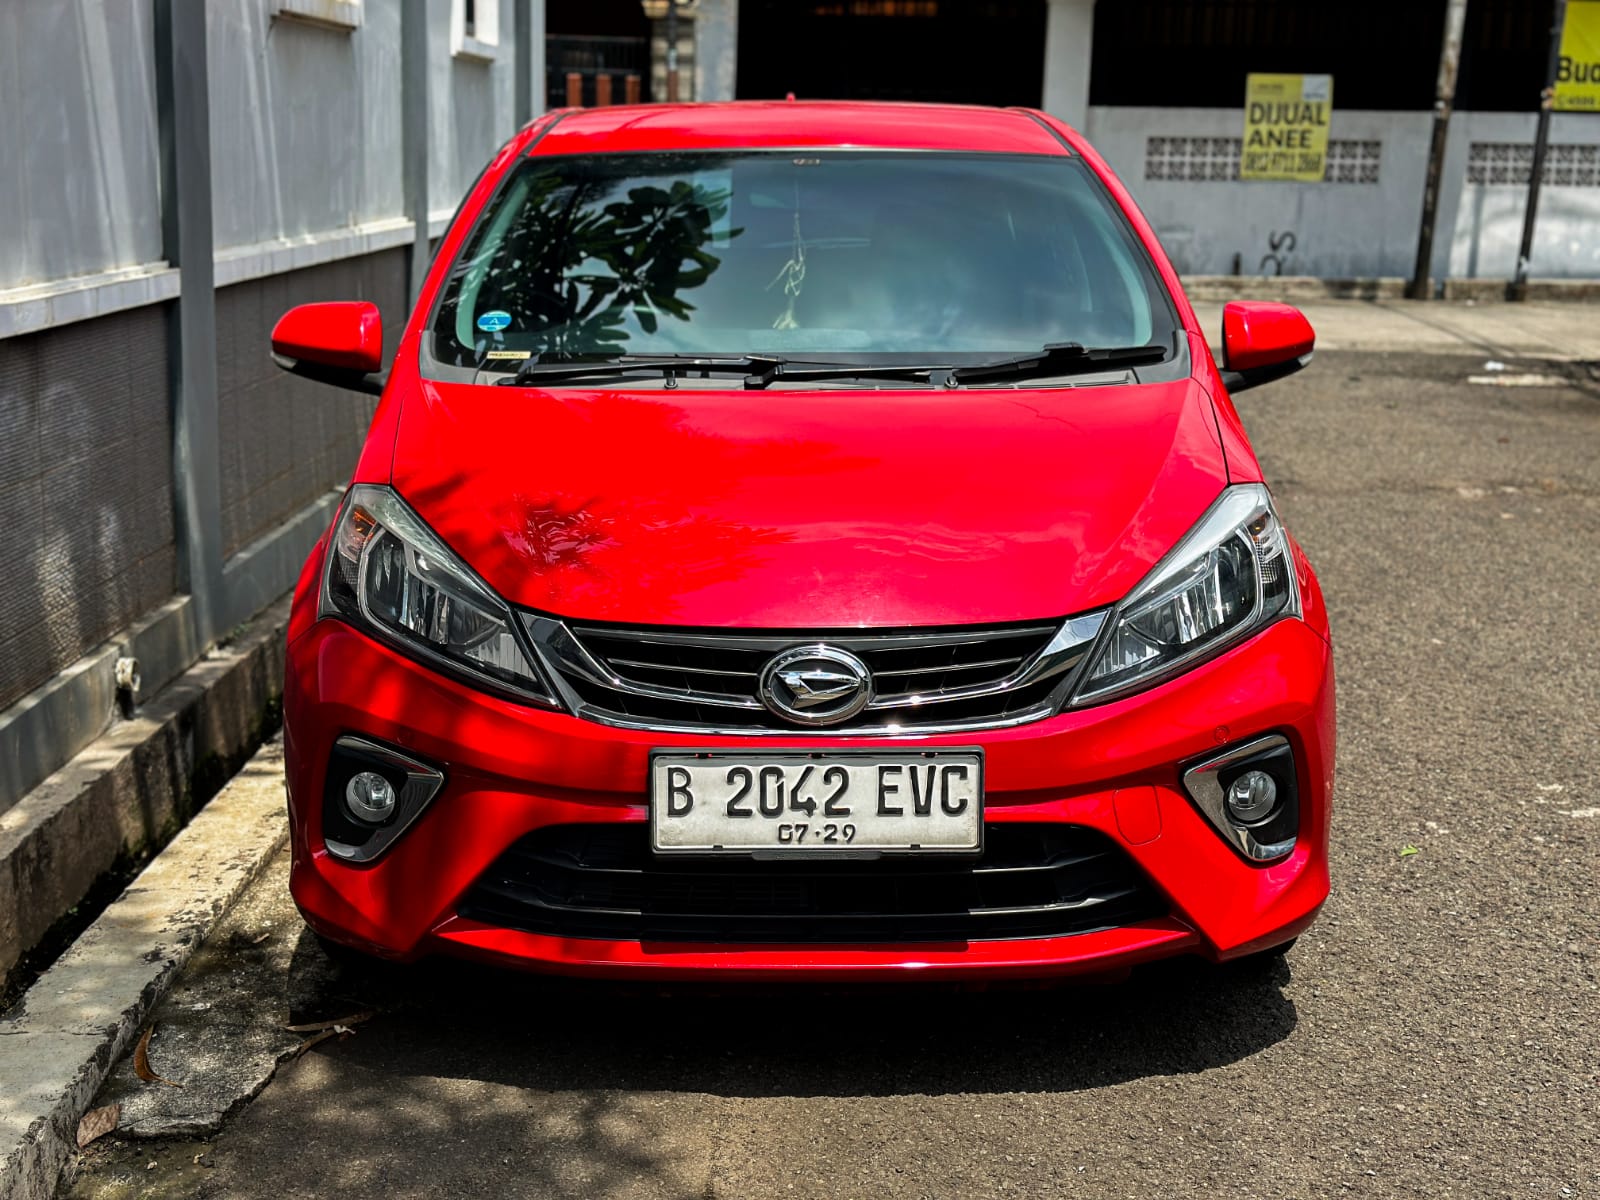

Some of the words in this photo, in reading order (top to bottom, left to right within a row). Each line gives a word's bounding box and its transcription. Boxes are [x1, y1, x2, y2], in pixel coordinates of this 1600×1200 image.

[1249, 101, 1326, 126] DIJUAL
[1247, 129, 1313, 149] ANEE
[667, 765, 694, 818] B
[725, 765, 852, 818] 2042
[876, 764, 969, 817] EVC
